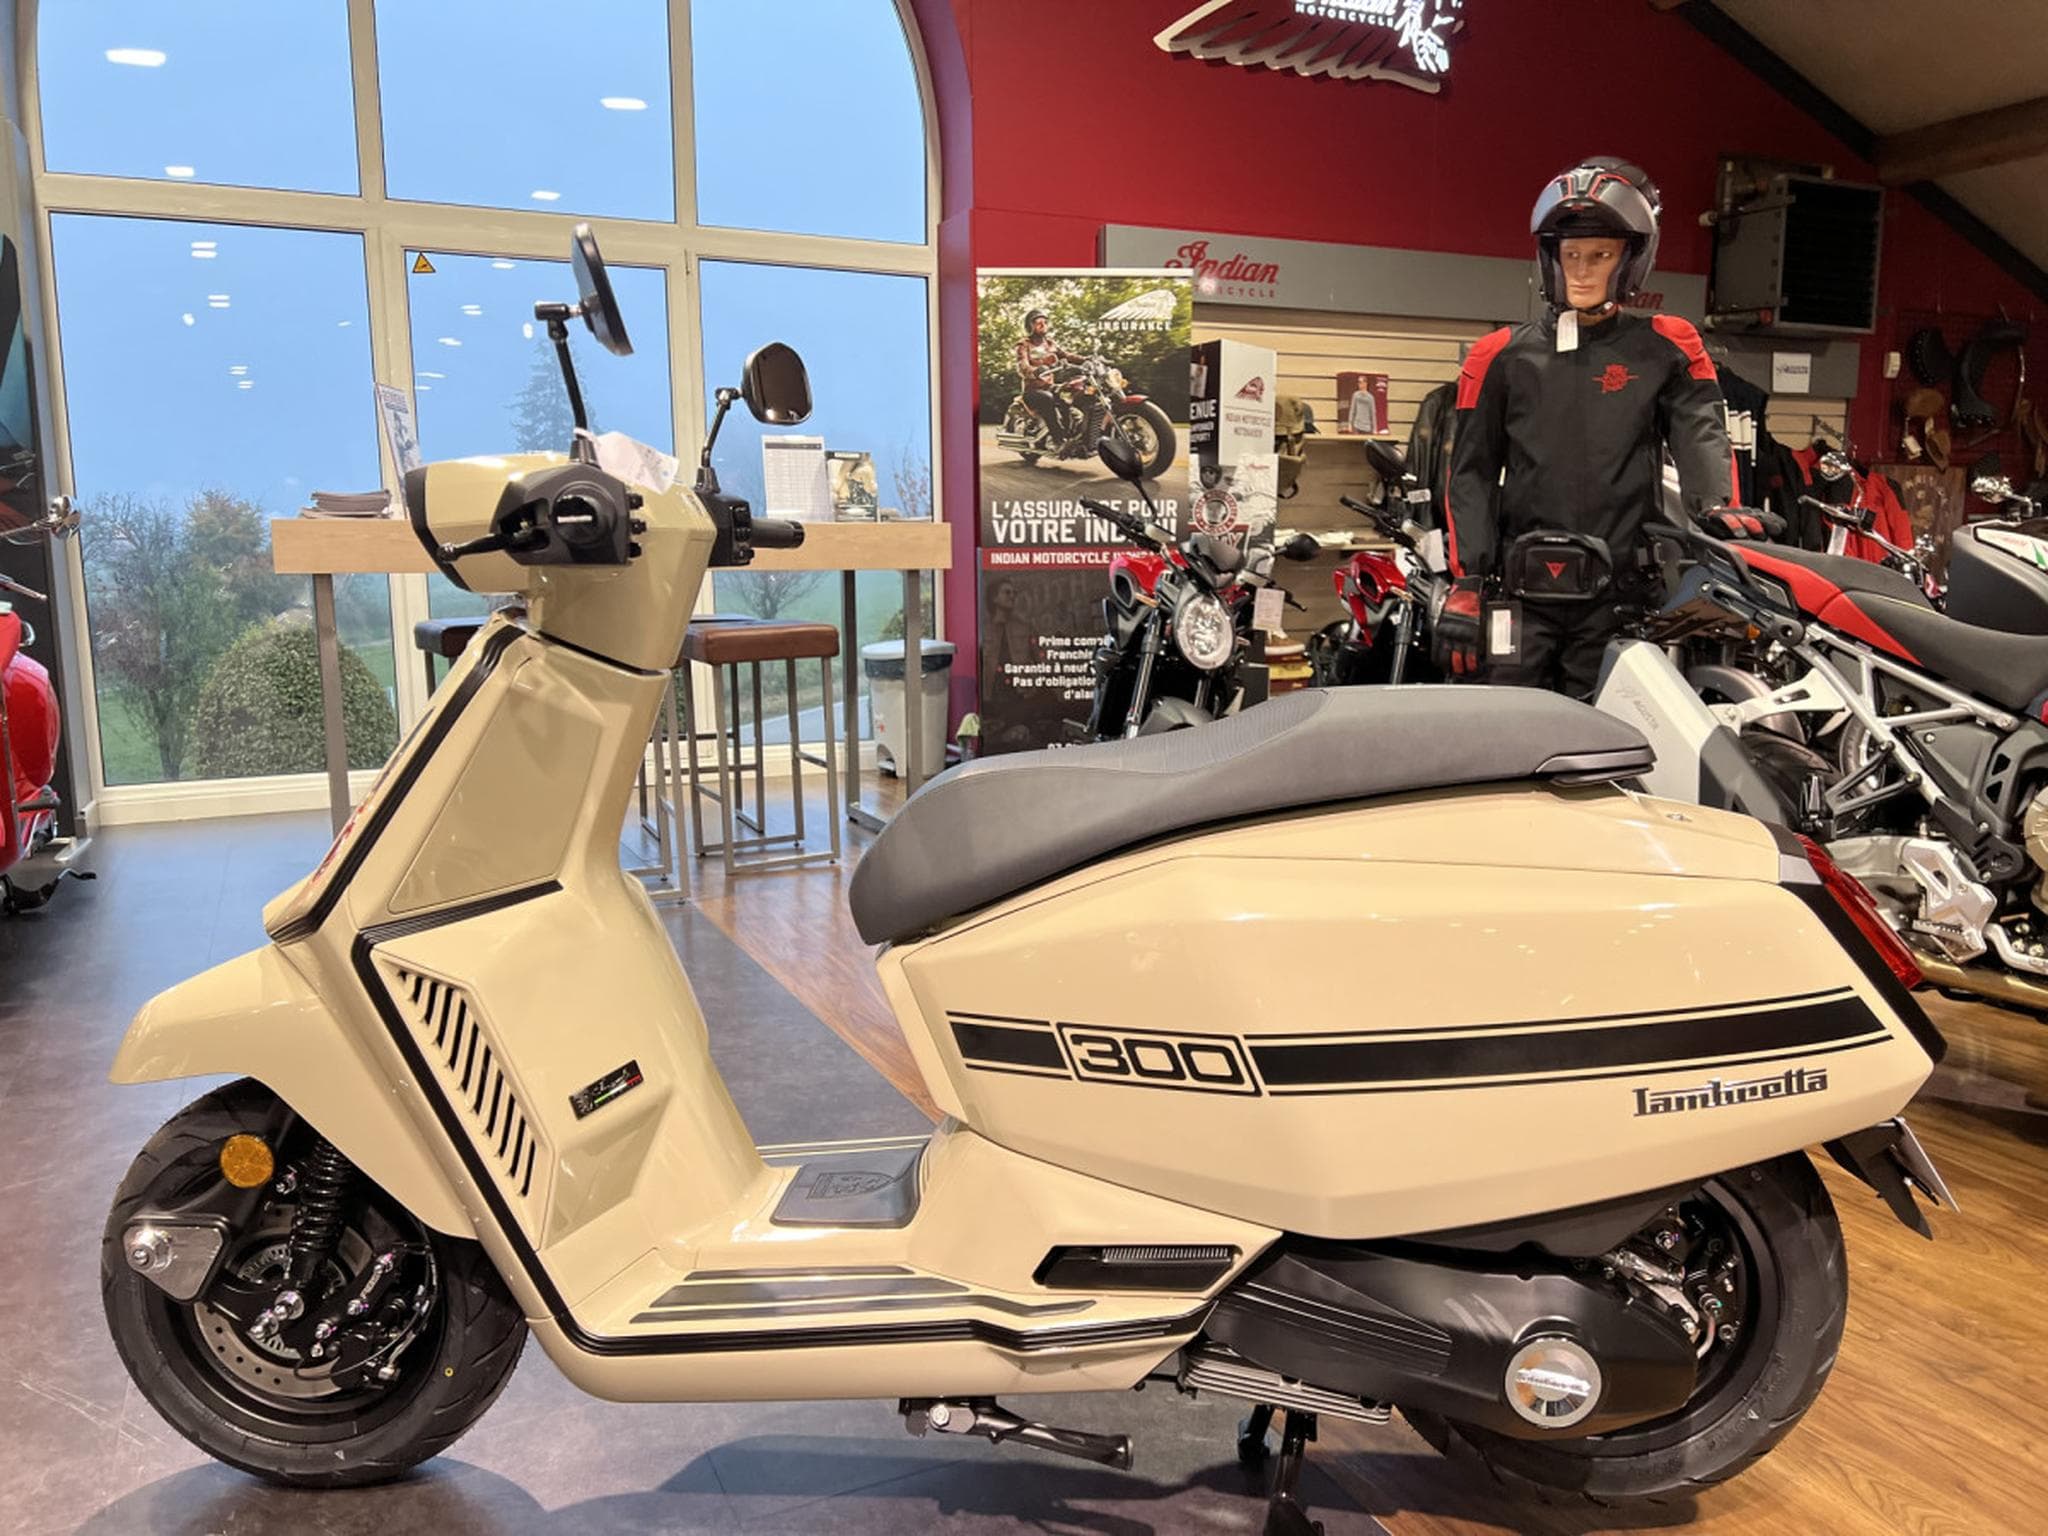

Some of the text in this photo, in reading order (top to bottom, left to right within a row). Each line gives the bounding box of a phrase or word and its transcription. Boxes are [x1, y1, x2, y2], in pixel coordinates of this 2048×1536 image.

[1295, 3, 1394, 28] MOTORCYCLE
[1164, 240, 1279, 284] Indian
[1099, 321, 1171, 331] INSURANCE
[992, 499, 1178, 518] L'ASSURAE POUR
[992, 519, 1076, 543] VOTRE
[991, 553, 1030, 564] INDIAN
[1032, 553, 1110, 564] MOTORCYCLE
[1039, 636, 1071, 646] Prime
[1004, 662, 1089, 673] Garantie à neuf
[1013, 677, 1033, 687] Pas
[1070, 1033, 1245, 1085] 300
